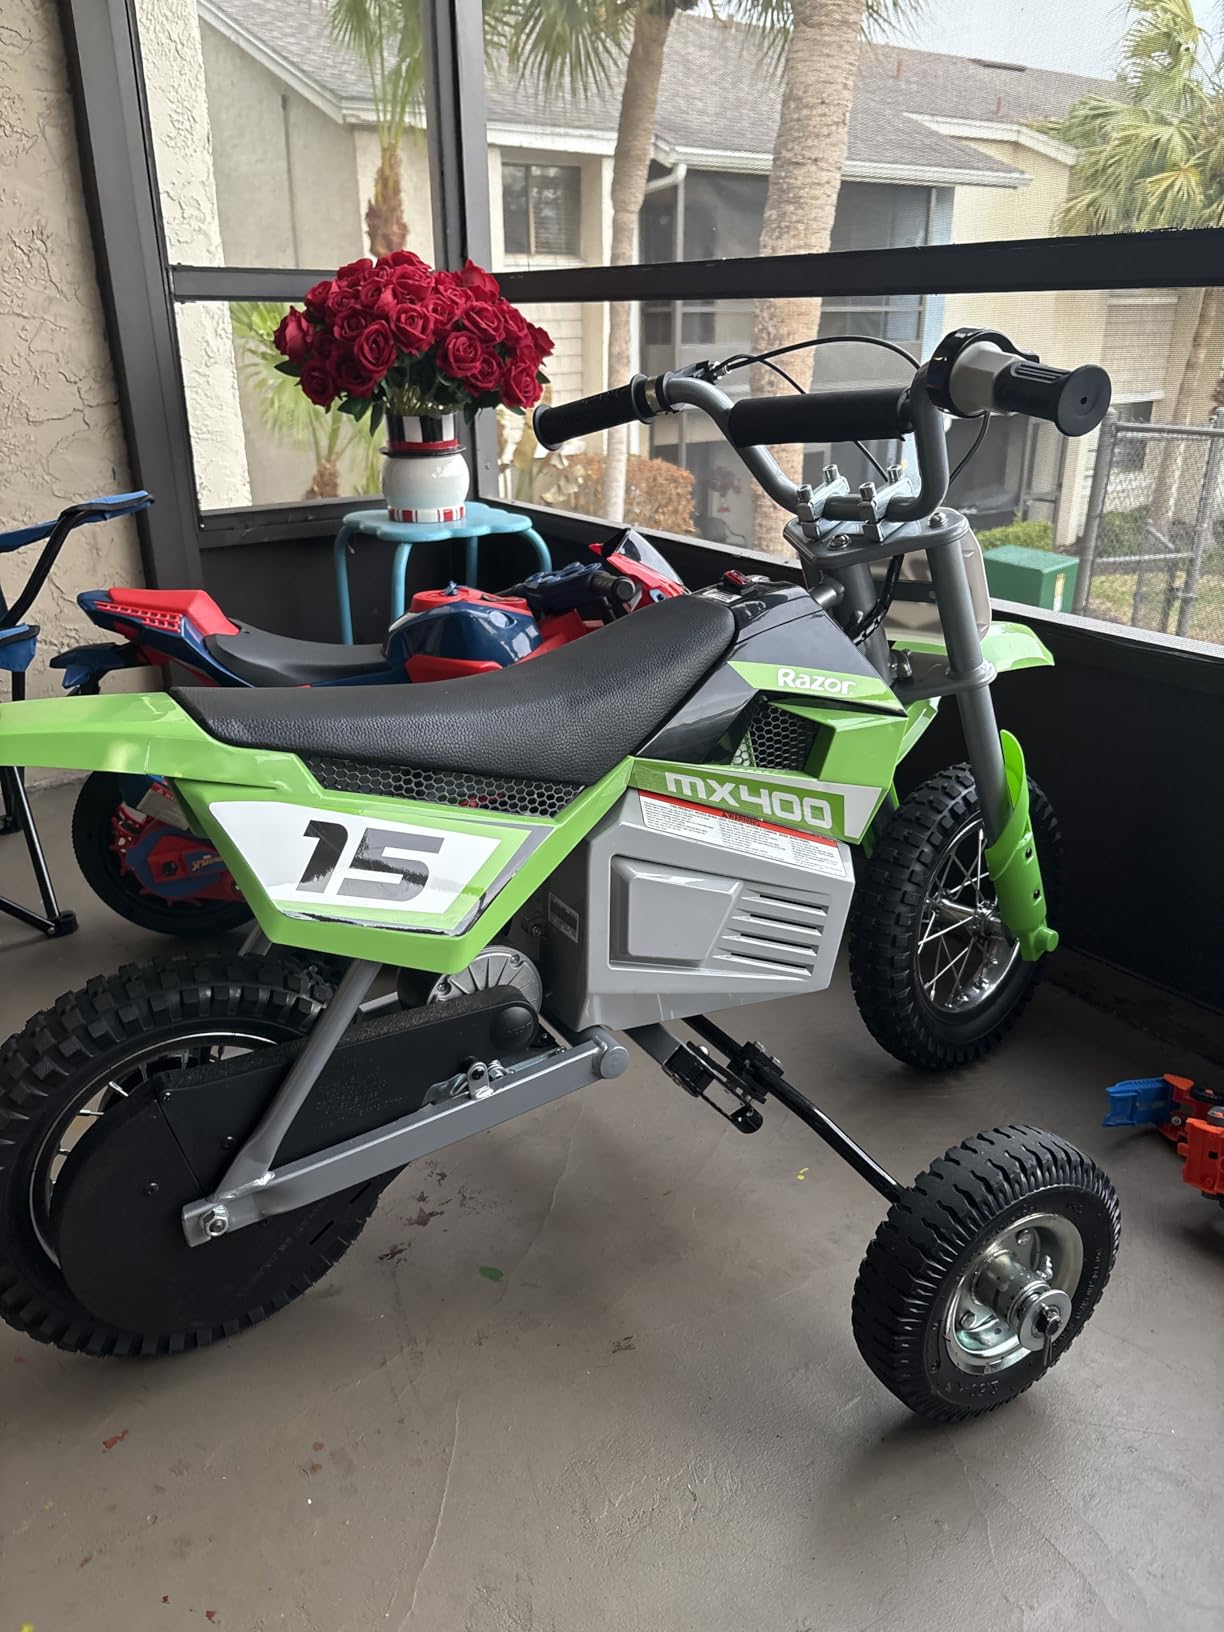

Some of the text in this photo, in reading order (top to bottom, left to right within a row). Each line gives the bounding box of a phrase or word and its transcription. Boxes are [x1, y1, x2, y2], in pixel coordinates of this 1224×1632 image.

[776, 668, 856, 695] Razor
[664, 771, 833, 830] MX400
[295, 819, 446, 902] 15
